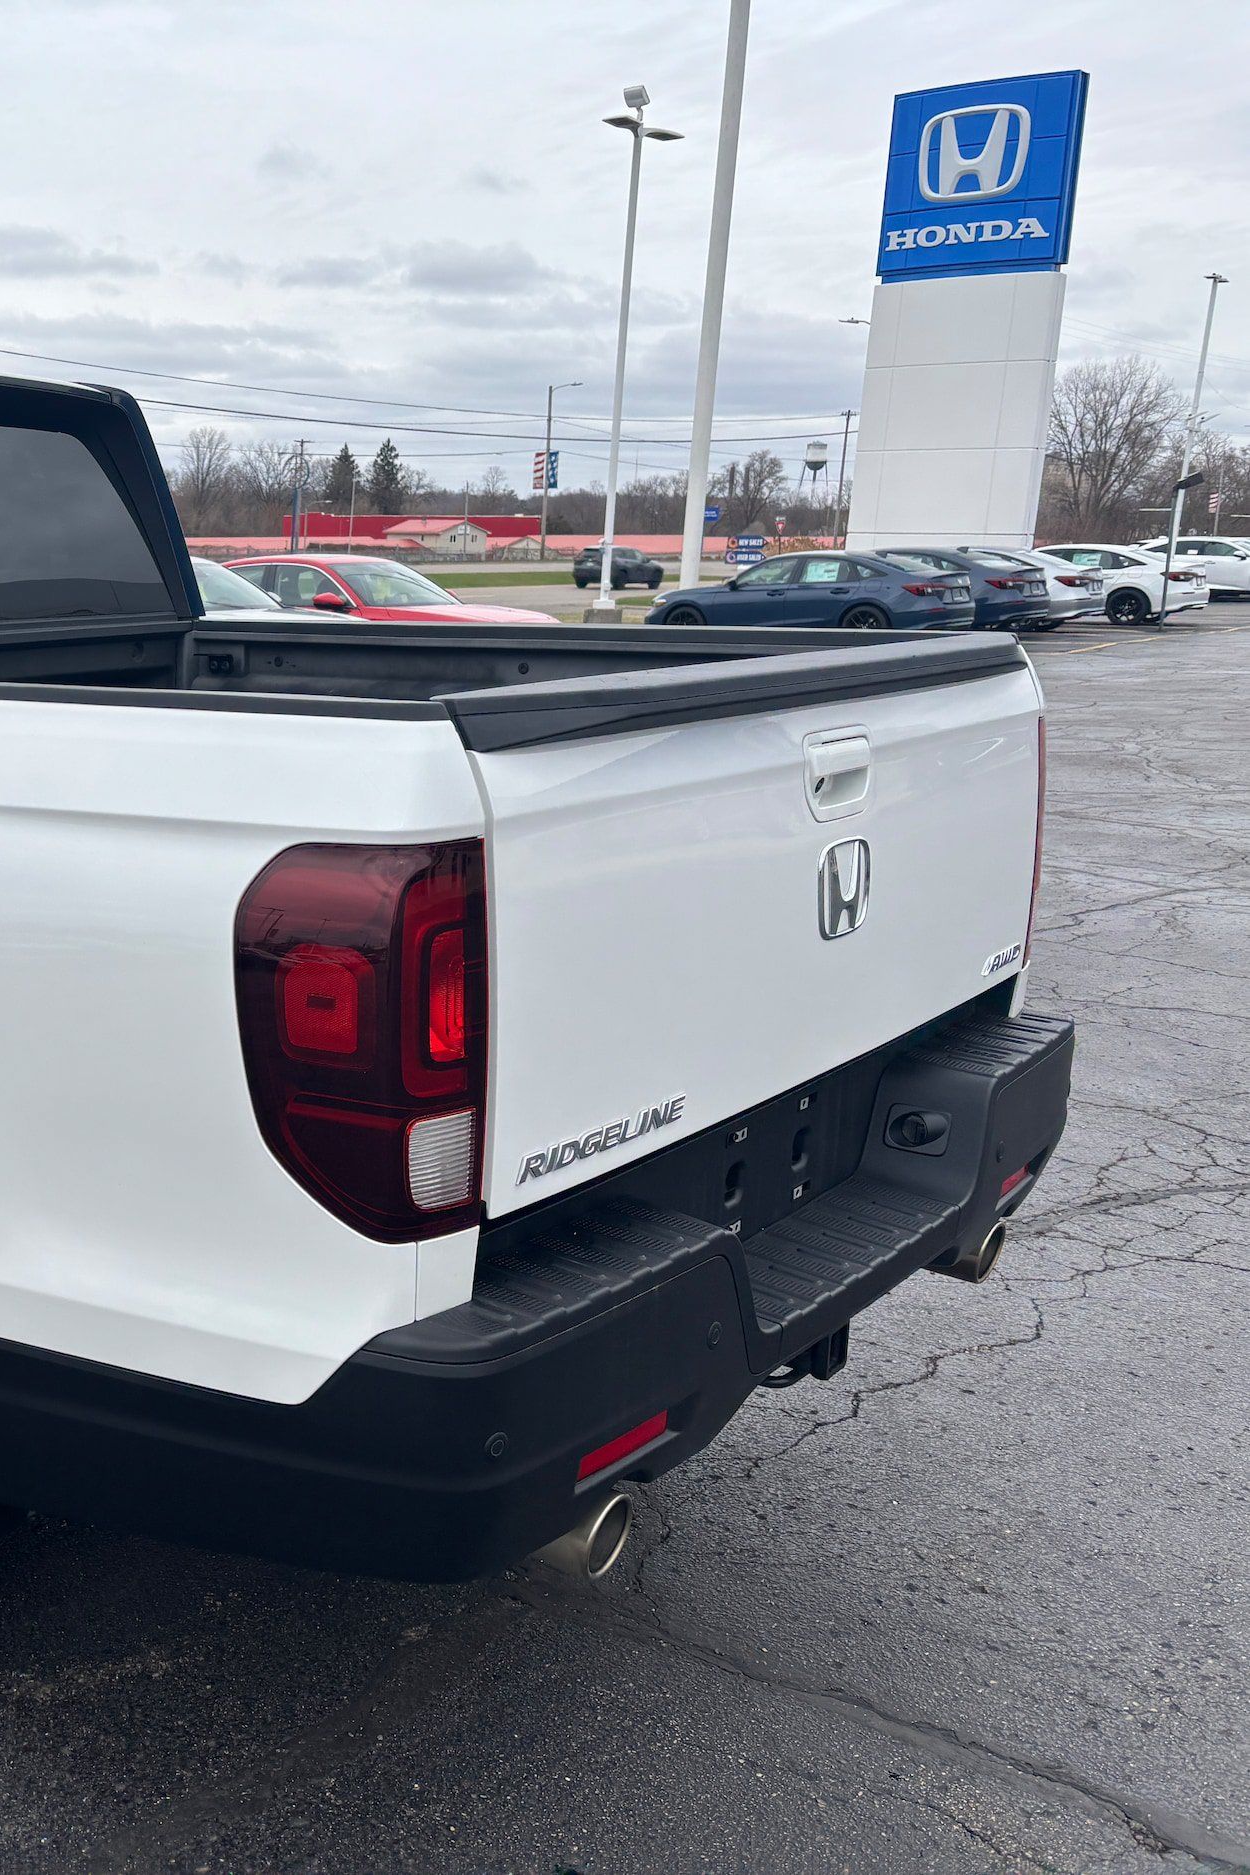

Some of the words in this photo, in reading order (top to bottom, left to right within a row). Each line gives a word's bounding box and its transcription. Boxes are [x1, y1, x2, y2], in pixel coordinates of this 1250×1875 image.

[885, 217, 1050, 252] HONDA
[749, 538, 764, 547] SALES
[981, 943, 1021, 977] AWD
[514, 1091, 687, 1187] RIDGELINE
